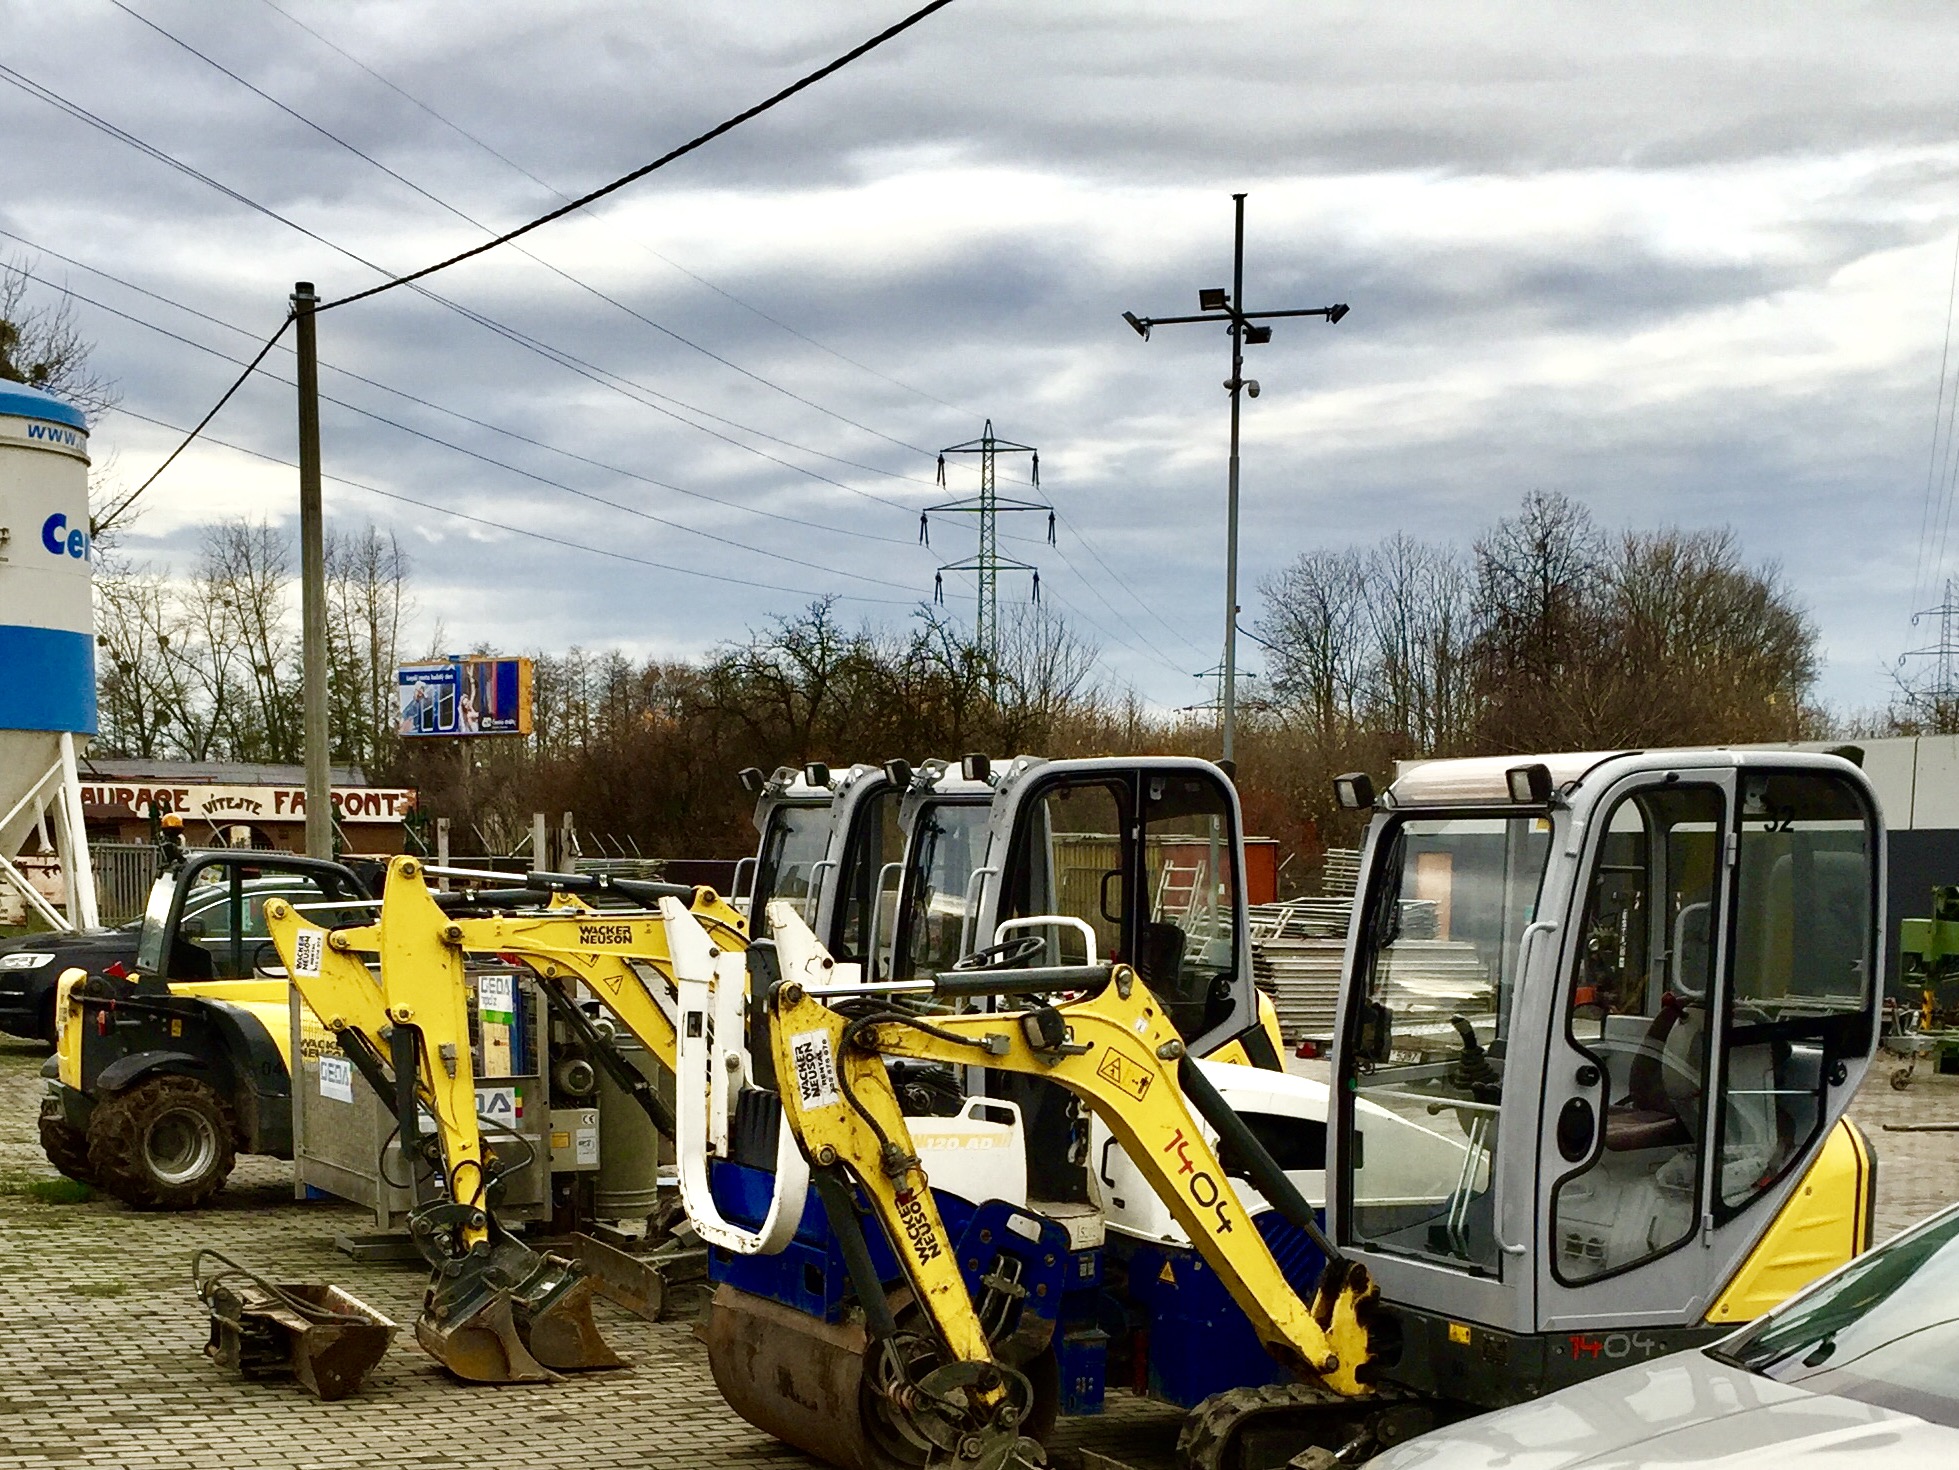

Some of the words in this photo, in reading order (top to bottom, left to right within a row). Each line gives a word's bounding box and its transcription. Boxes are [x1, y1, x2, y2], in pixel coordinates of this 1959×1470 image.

[202, 793, 262, 816] VÍTEJTE
[579, 925, 631, 935] WACKER
[580, 935, 632, 944] NEUSON
[300, 1039, 340, 1049] WACK
[795, 1045, 811, 1100] WACKER
[803, 1042, 820, 1097] NEUSON
[1164, 1128, 1232, 1233] 1404
[1568, 1333, 1655, 1360] 1404
